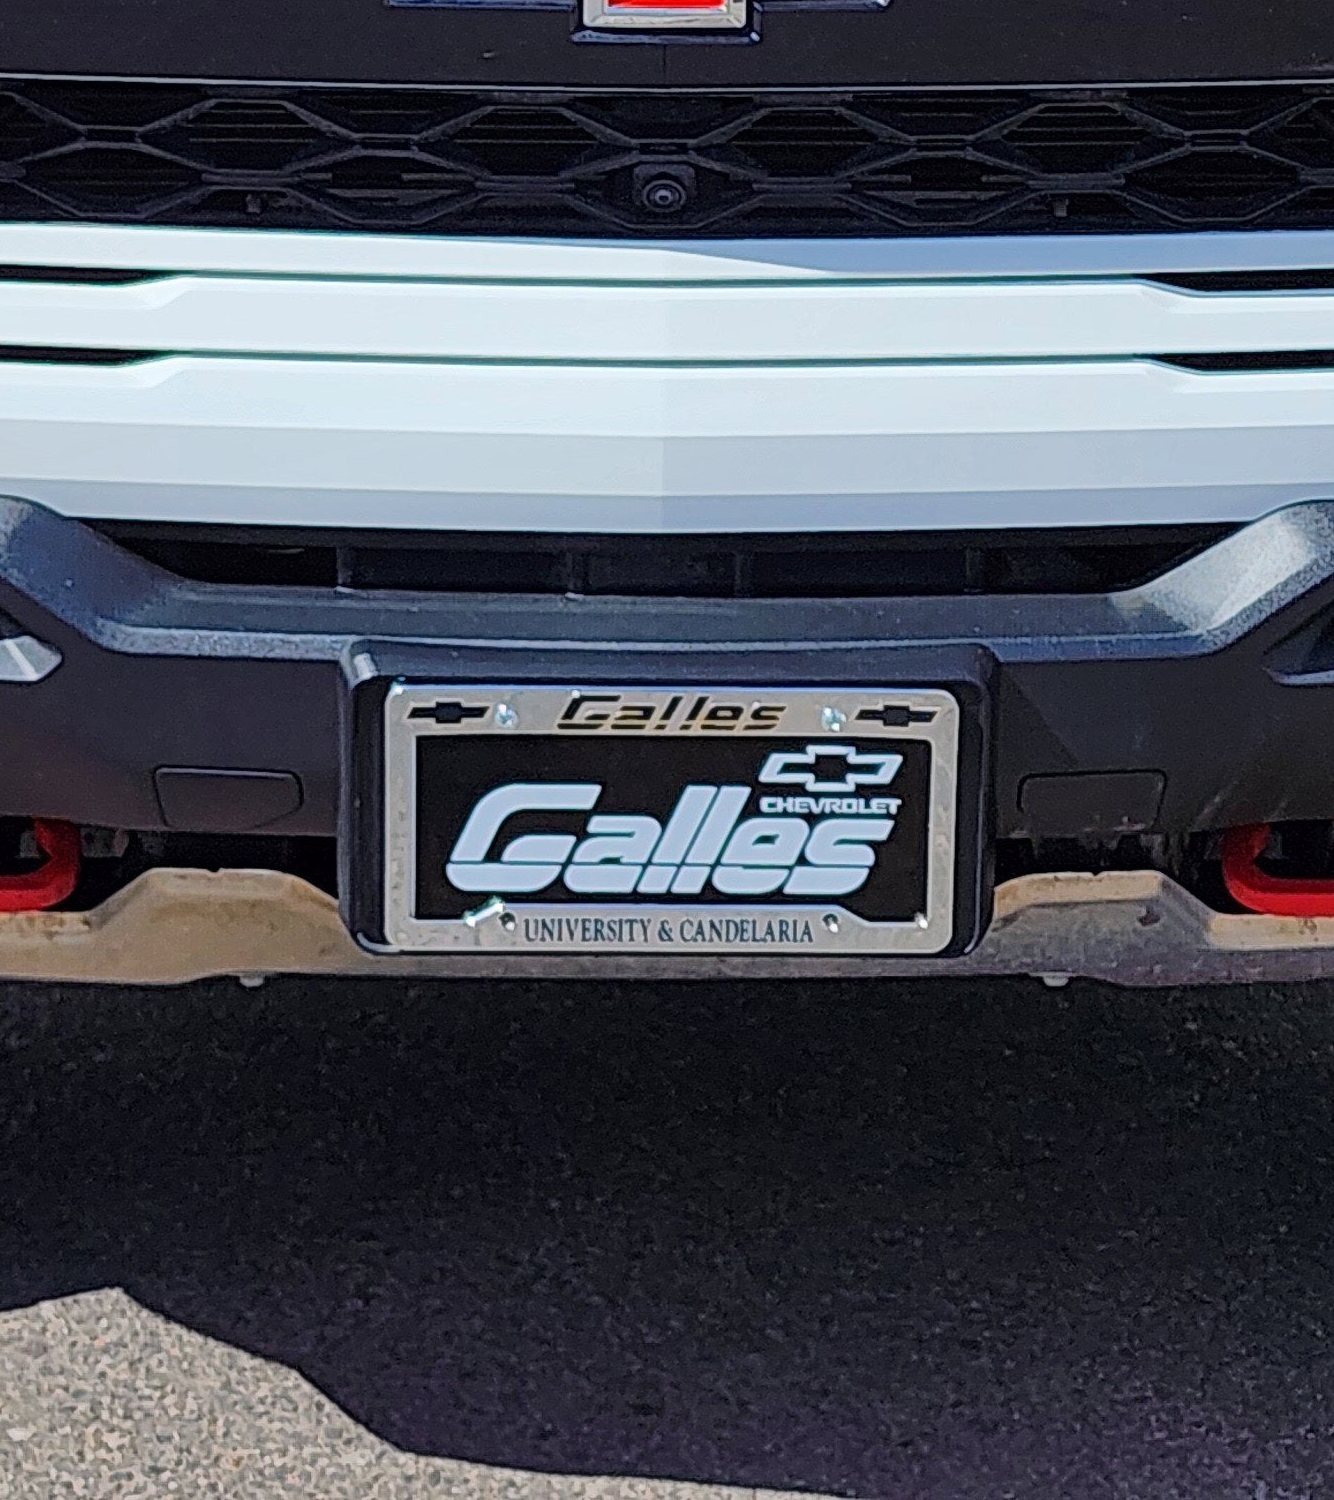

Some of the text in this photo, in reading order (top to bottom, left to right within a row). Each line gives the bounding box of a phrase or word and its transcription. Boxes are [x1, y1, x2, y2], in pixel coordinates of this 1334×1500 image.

[556, 695, 786, 731] Galles
[759, 796, 902, 814] CHEVROLET
[446, 783, 895, 895] Galles
[522, 916, 814, 944] UNIVERSITY & CANDELARIA
